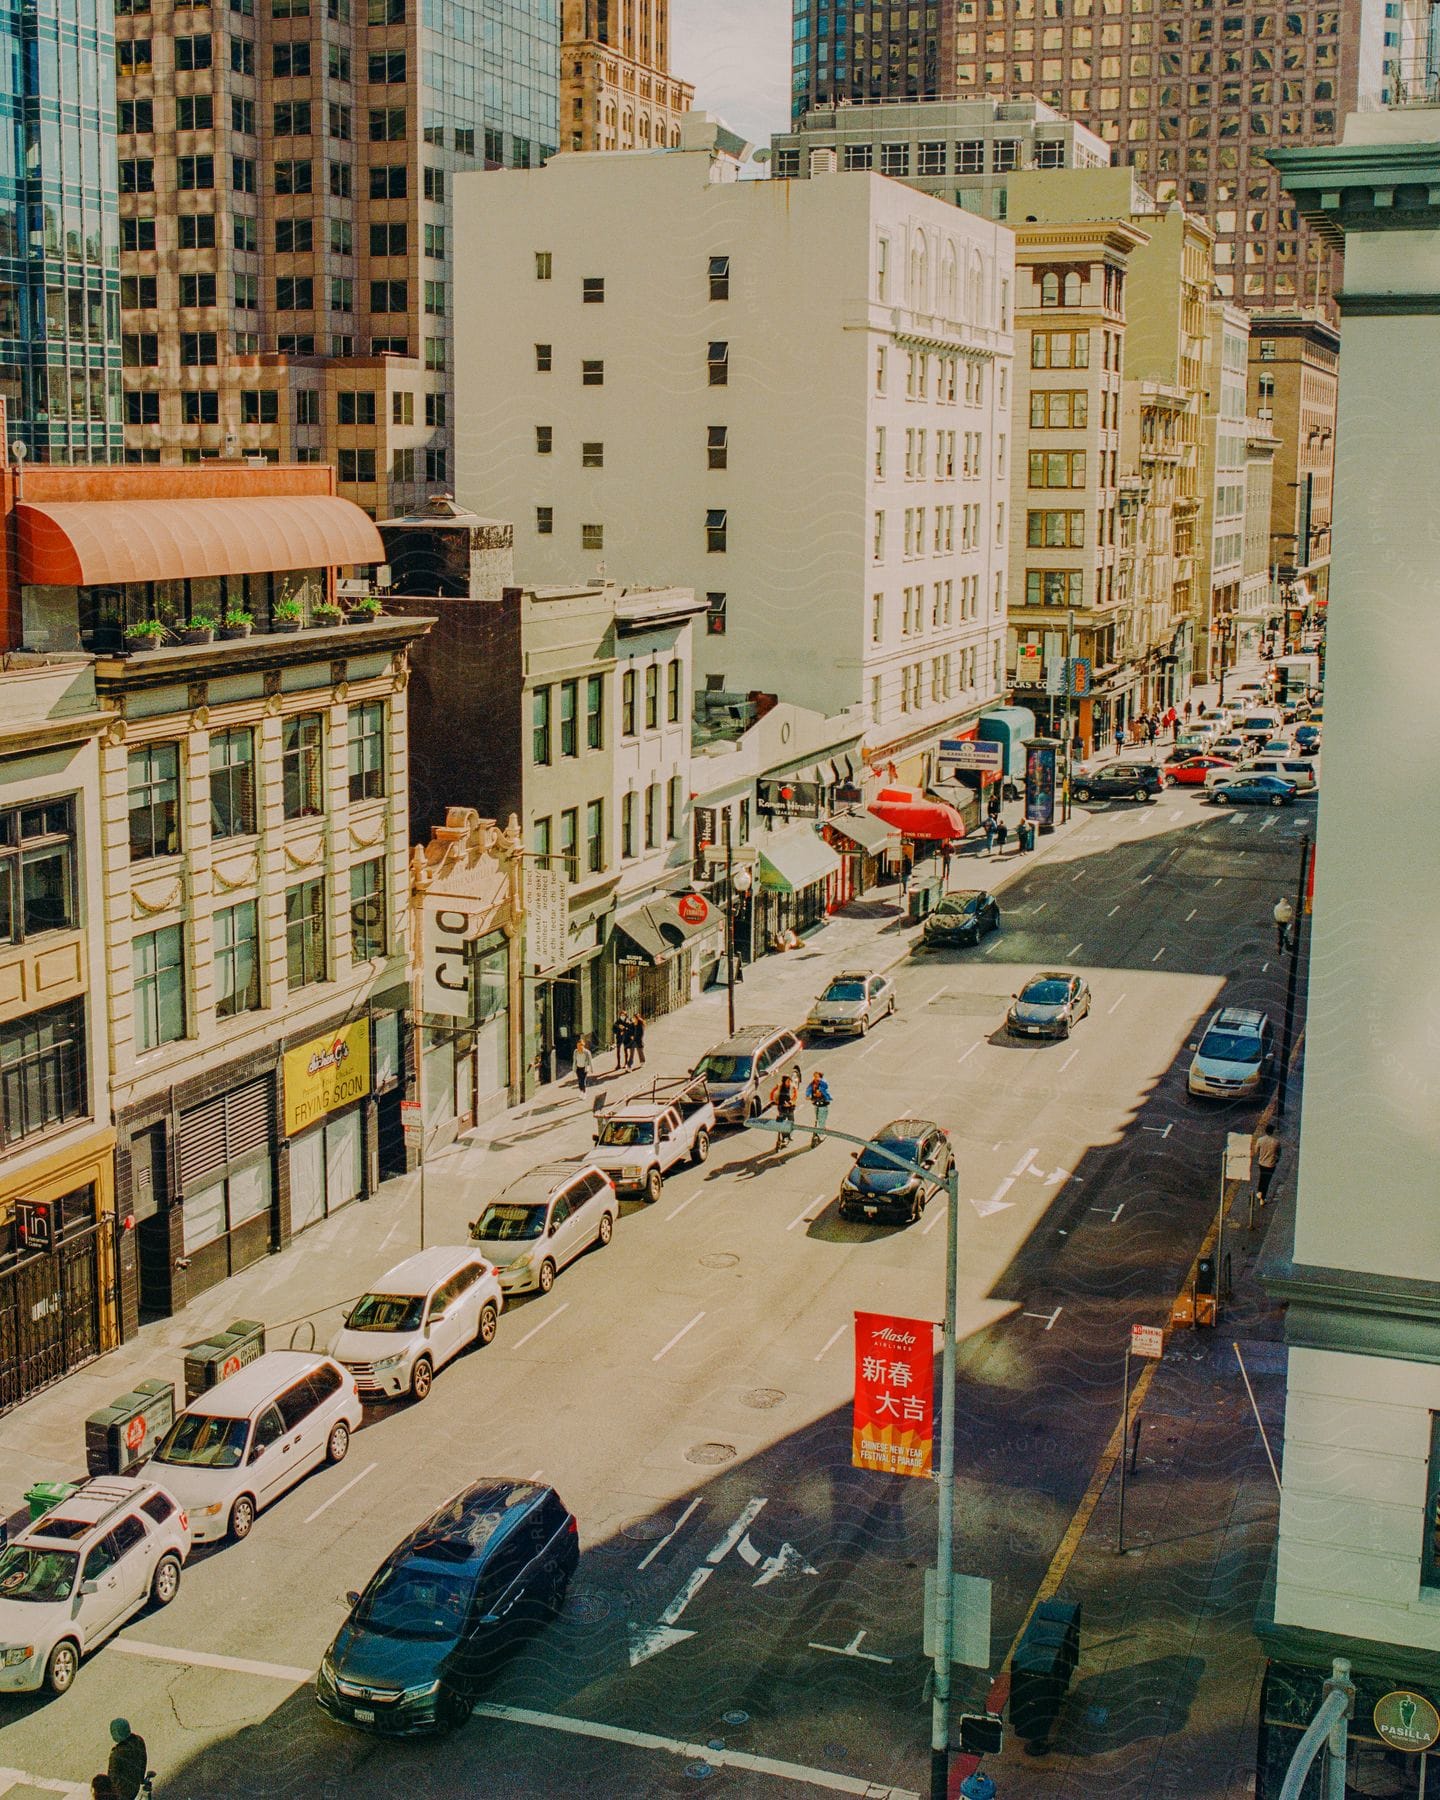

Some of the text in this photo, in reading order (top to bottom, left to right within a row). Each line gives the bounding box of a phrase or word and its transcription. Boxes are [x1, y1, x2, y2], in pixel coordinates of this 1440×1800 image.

[758, 798, 816, 813] Ramen Hiroshi
[702, 811, 712, 841] Hiroshi
[295, 1091, 330, 1125] FRYING
[333, 1074, 363, 1104] SOON
[871, 1327, 917, 1345] Alaska
[873, 1341, 913, 1352] AIRLINES
[862, 1355, 913, 1388] 新春
[875, 1390, 926, 1422] 大吉
[861, 1440, 923, 1458] CHINESE NEW YEAR
[860, 1450, 890, 1464] FESTIVAL
[897, 1456, 923, 1468] PARADE
[1380, 1724, 1431, 1741] PASILLA
